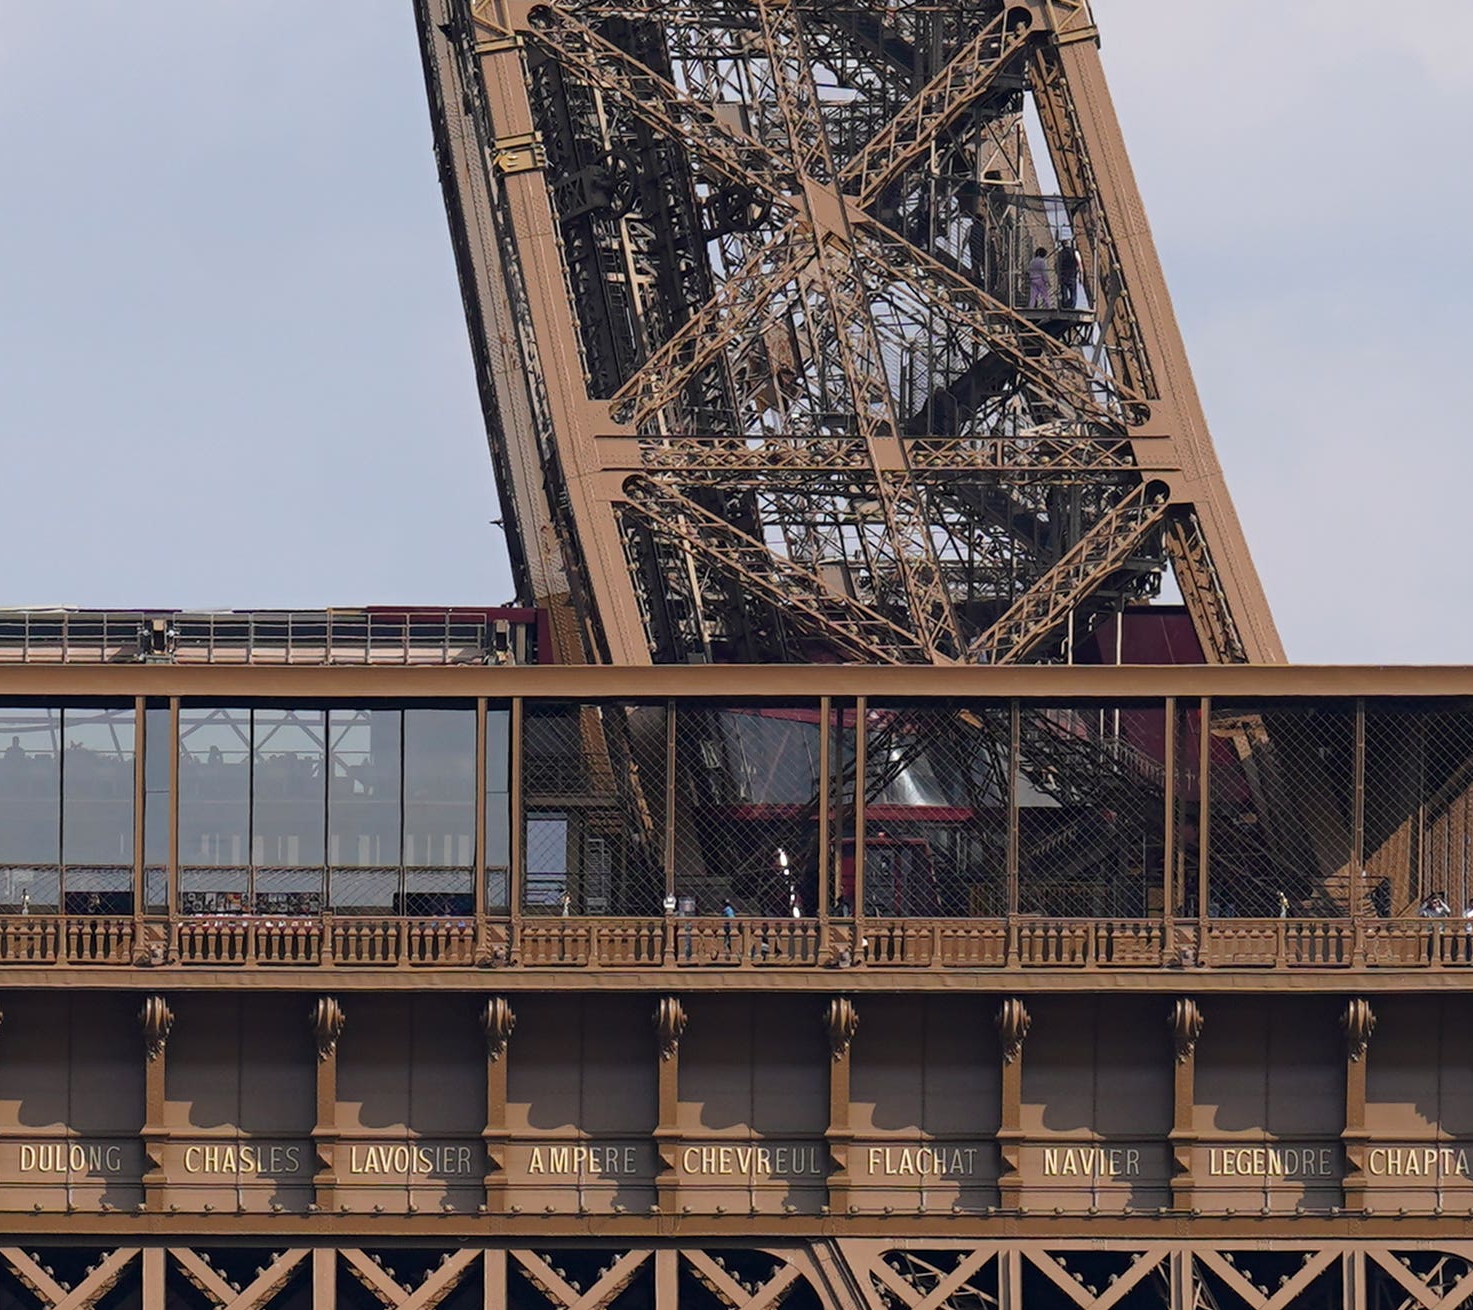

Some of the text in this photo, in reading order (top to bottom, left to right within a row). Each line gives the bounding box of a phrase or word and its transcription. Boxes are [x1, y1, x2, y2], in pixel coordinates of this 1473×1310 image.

[20, 1144, 122, 1174] DULONG
[185, 1145, 300, 1174] CHASLES
[351, 1146, 473, 1175] LAVOISIER
[528, 1146, 636, 1175] AMPERE
[683, 1147, 821, 1176] CHEVREUL
[867, 1147, 977, 1176] FLACHAT
[1043, 1147, 1140, 1177] NAVIER
[1209, 1148, 1332, 1178] LEGENDRE
